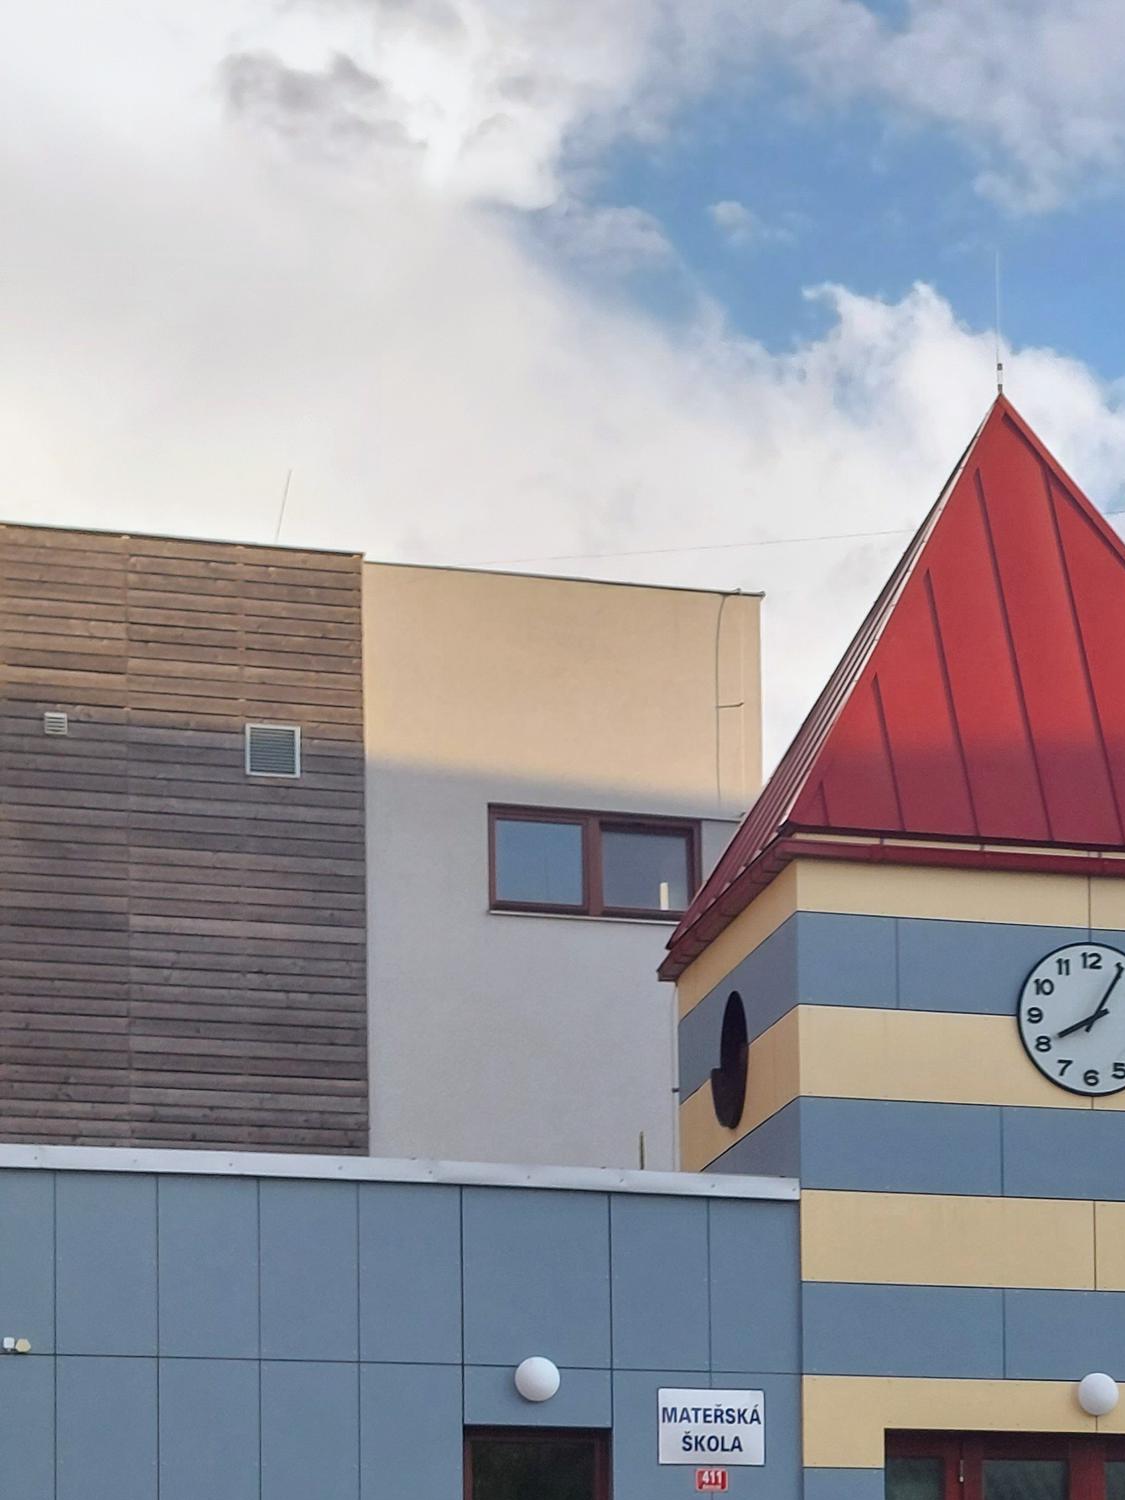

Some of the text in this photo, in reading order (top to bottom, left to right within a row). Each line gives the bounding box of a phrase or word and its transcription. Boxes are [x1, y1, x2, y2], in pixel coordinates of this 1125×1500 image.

[1056, 958, 1070, 976] 11
[1081, 952, 1103, 970] 12
[1034, 978, 1054, 996] 10
[1027, 1007, 1044, 1024] 9
[1035, 1036, 1053, 1052] 8
[1057, 1059, 1073, 1076] 7
[1083, 1070, 1099, 1086] 6
[661, 1403, 762, 1426] MATEŘSKÁ
[681, 1430, 743, 1453] ŠKOLA
[702, 1470, 722, 1484] 411
